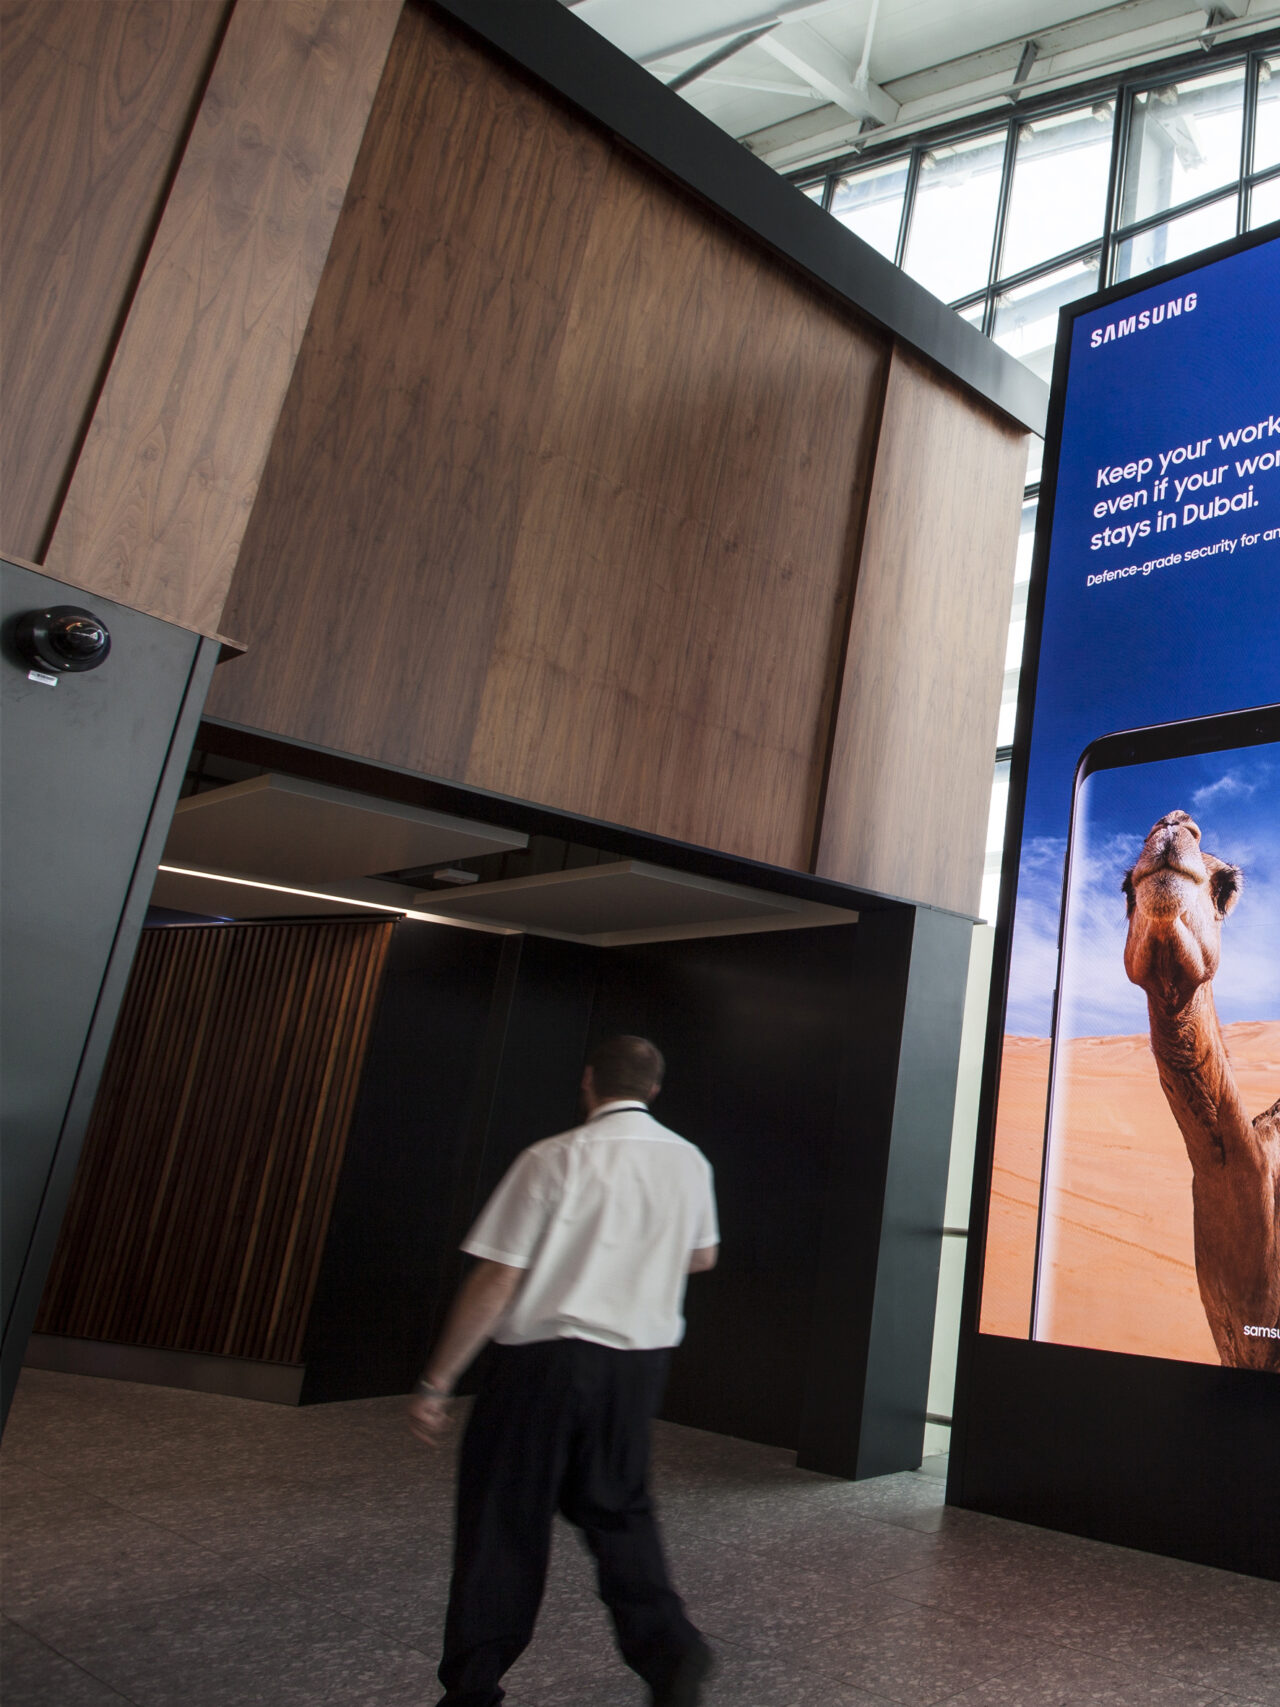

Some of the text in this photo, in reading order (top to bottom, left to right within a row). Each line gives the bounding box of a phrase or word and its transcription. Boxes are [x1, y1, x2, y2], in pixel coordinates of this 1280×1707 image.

[1090, 293, 1197, 348] SAMSUNG
[1096, 456, 1153, 488] Keep
[1158, 436, 1213, 475] your
[1089, 485, 1259, 551] stays in Dubai.
[1093, 489, 1148, 519] even
[1153, 478, 1169, 503] if
[1174, 463, 1229, 503] your
[1086, 552, 1182, 588] Defence-grade
[1184, 537, 1238, 564] security
[1241, 532, 1261, 549] for
